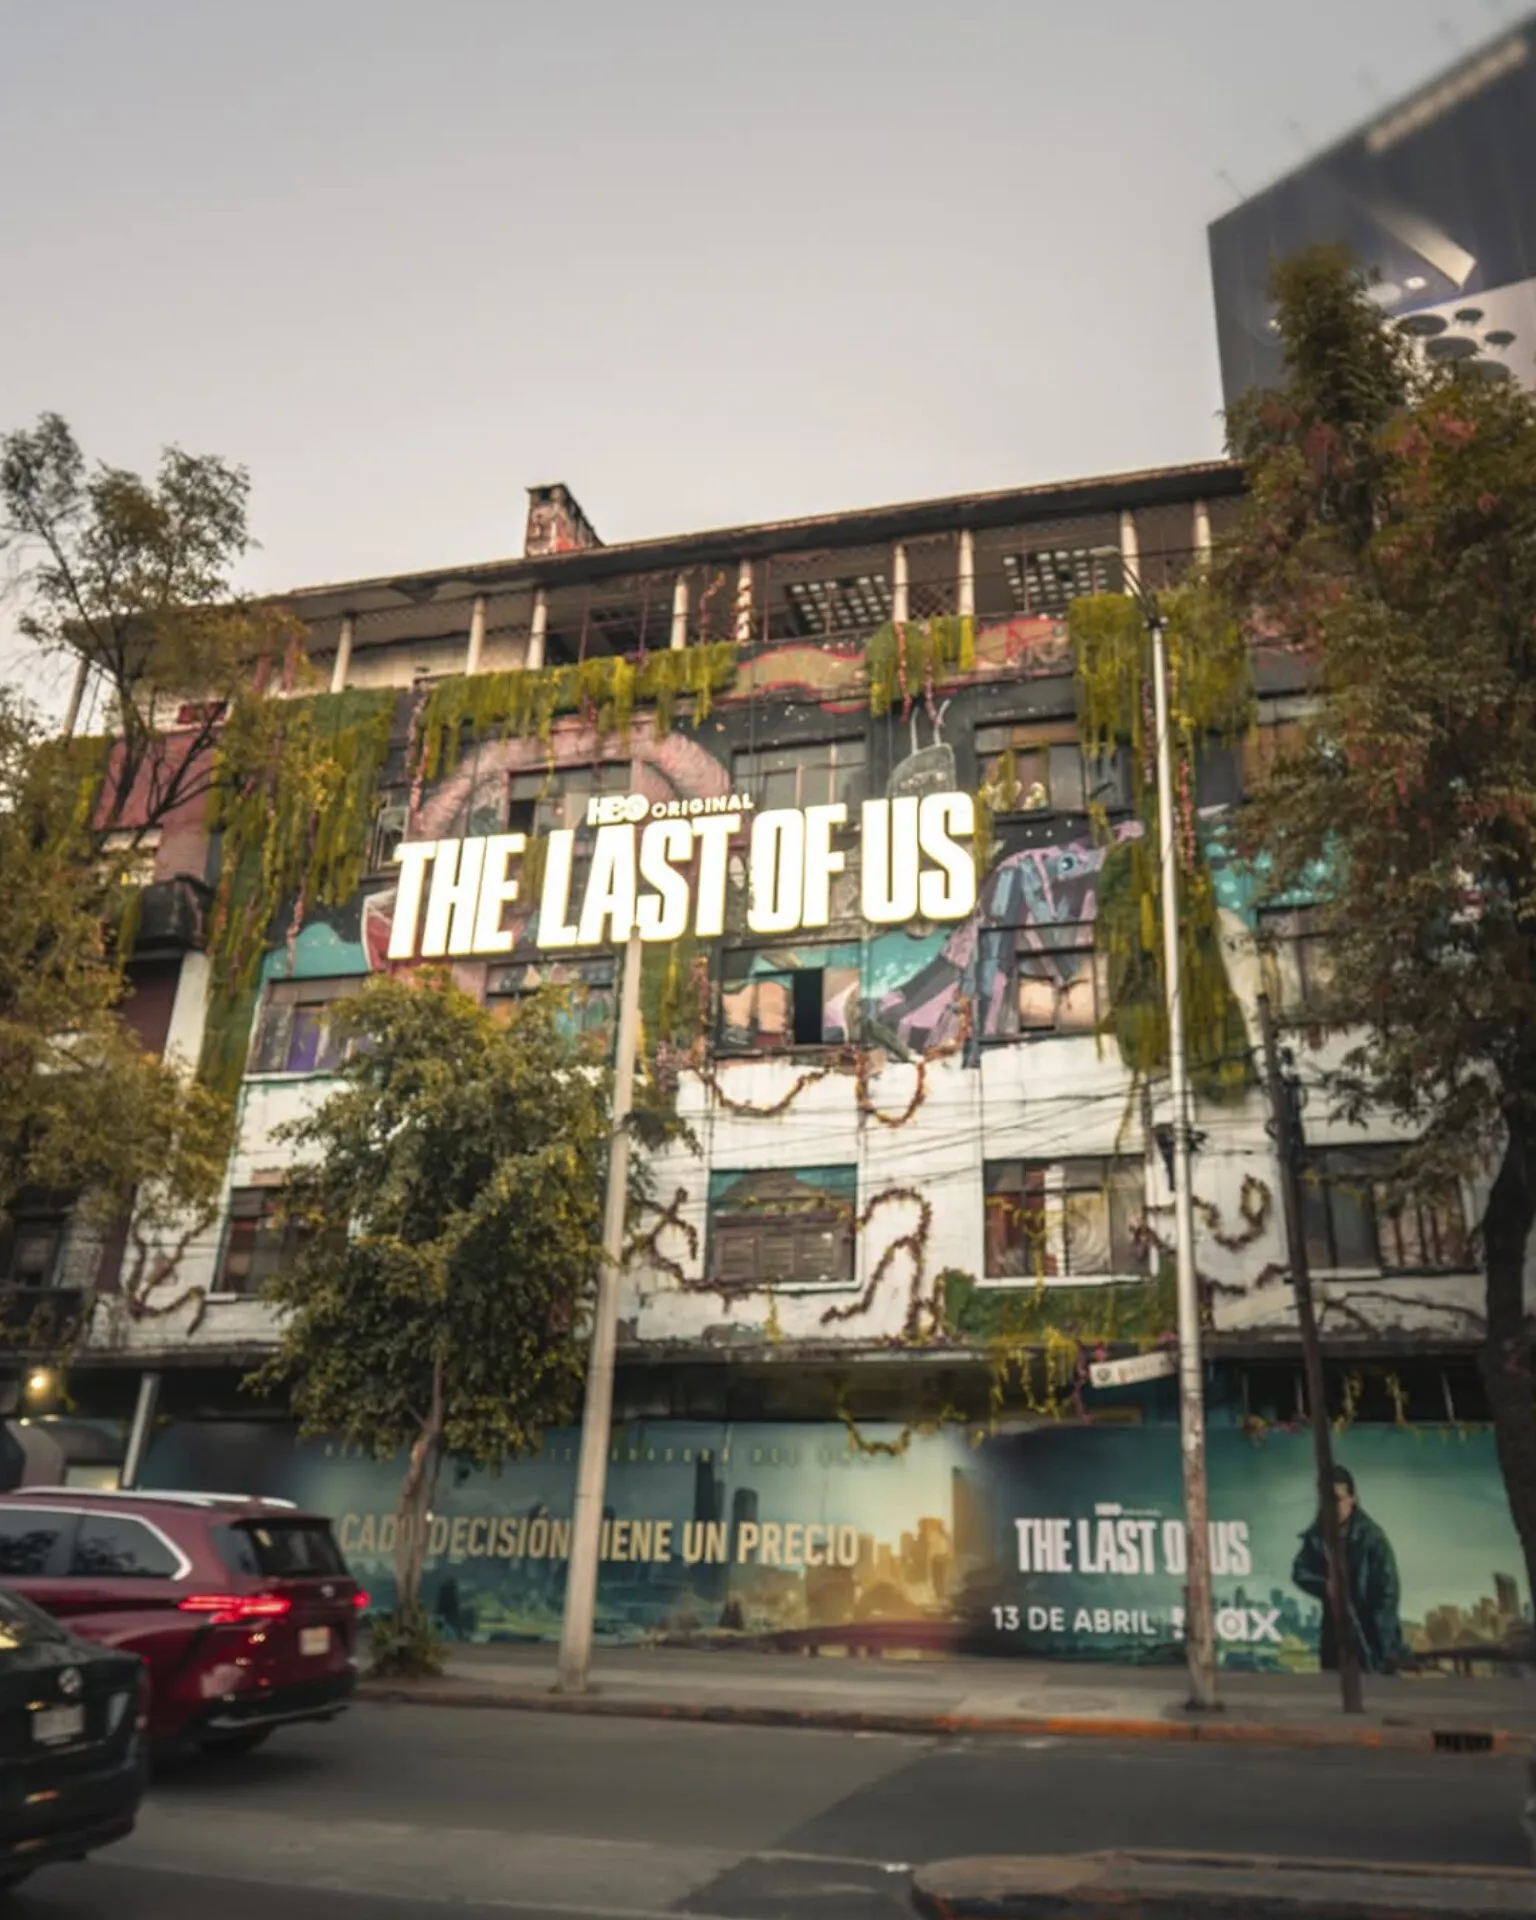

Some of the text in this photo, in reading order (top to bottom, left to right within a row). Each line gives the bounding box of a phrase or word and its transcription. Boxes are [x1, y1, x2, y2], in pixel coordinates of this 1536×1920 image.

[587, 793, 754, 827] HBO ORIGINAL
[388, 791, 977, 959] THE LAST OF US
[429, 1503, 571, 1559] DECISIÓN
[598, 1518, 674, 1563] IENE
[682, 1520, 728, 1564] UN
[736, 1522, 859, 1567] PRECIO
[1015, 1517, 1252, 1575] THE LAST O US
[992, 1605, 1157, 1635] 13 DE ABRIL
